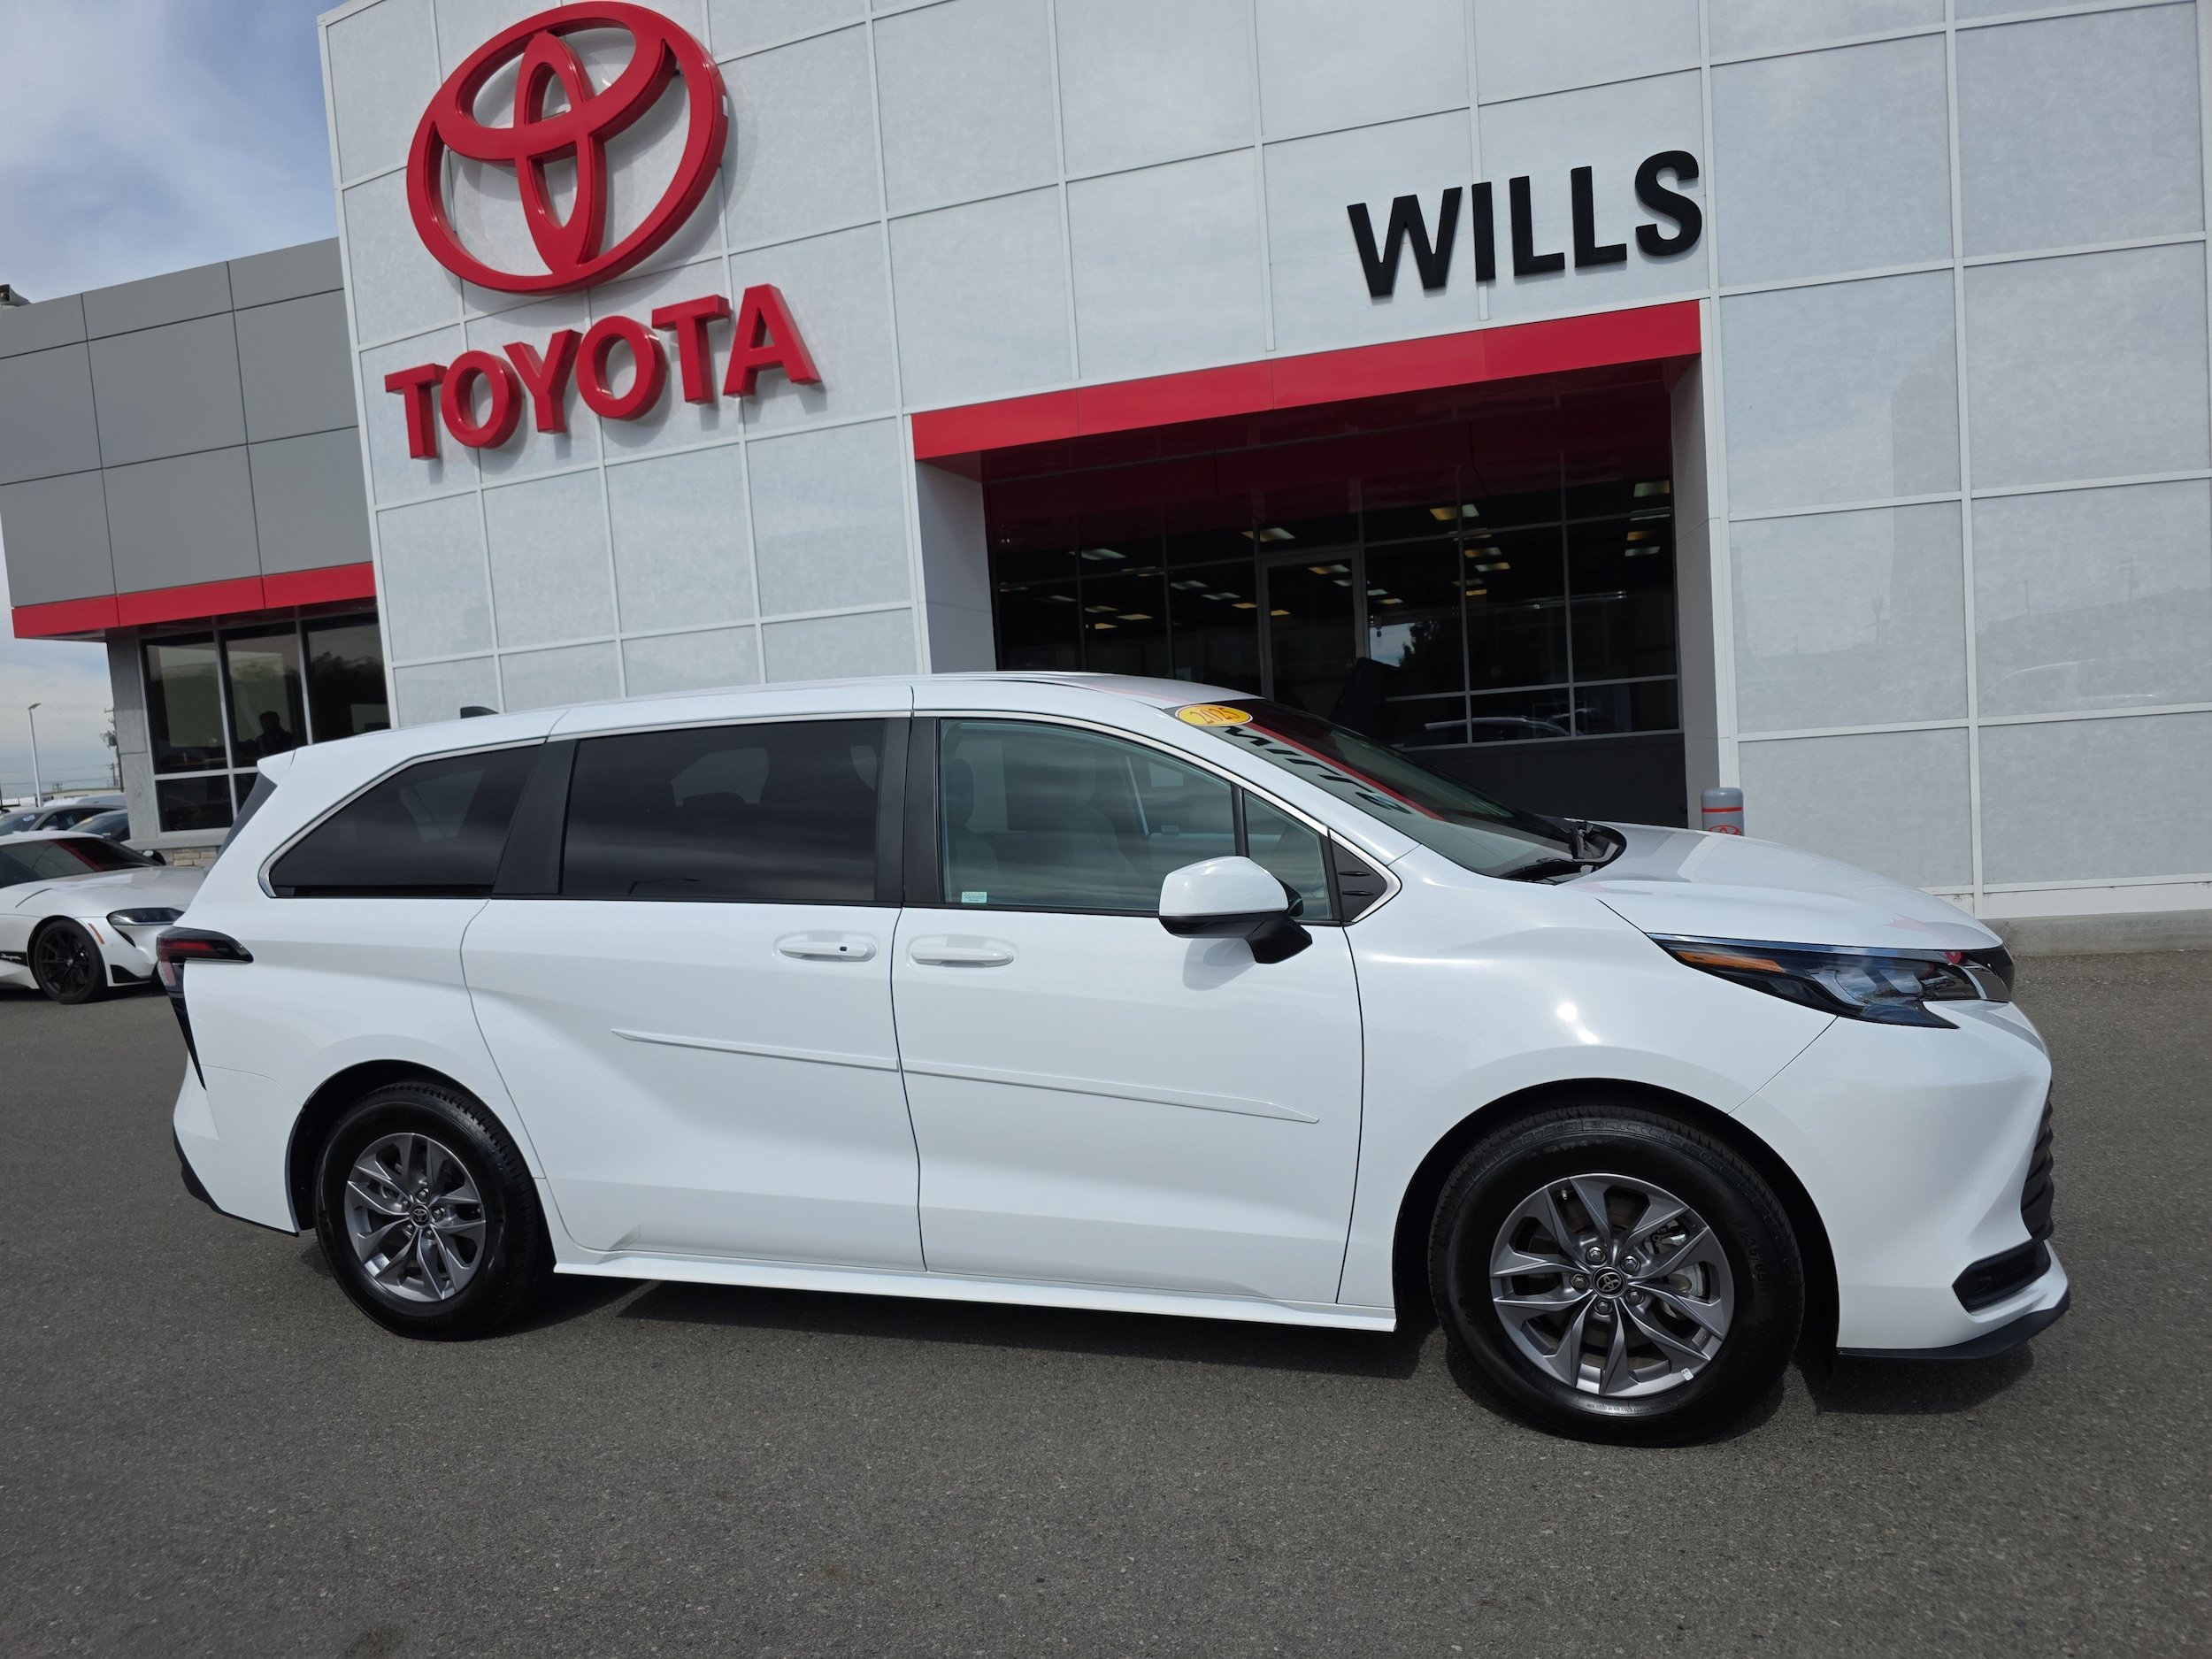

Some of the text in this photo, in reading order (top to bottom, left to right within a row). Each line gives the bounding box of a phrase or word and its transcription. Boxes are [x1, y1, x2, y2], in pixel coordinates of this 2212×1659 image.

[1347, 150, 1703, 298] WILLS
[385, 284, 822, 460] TOYOTA
[1189, 707, 1240, 725] 2025
